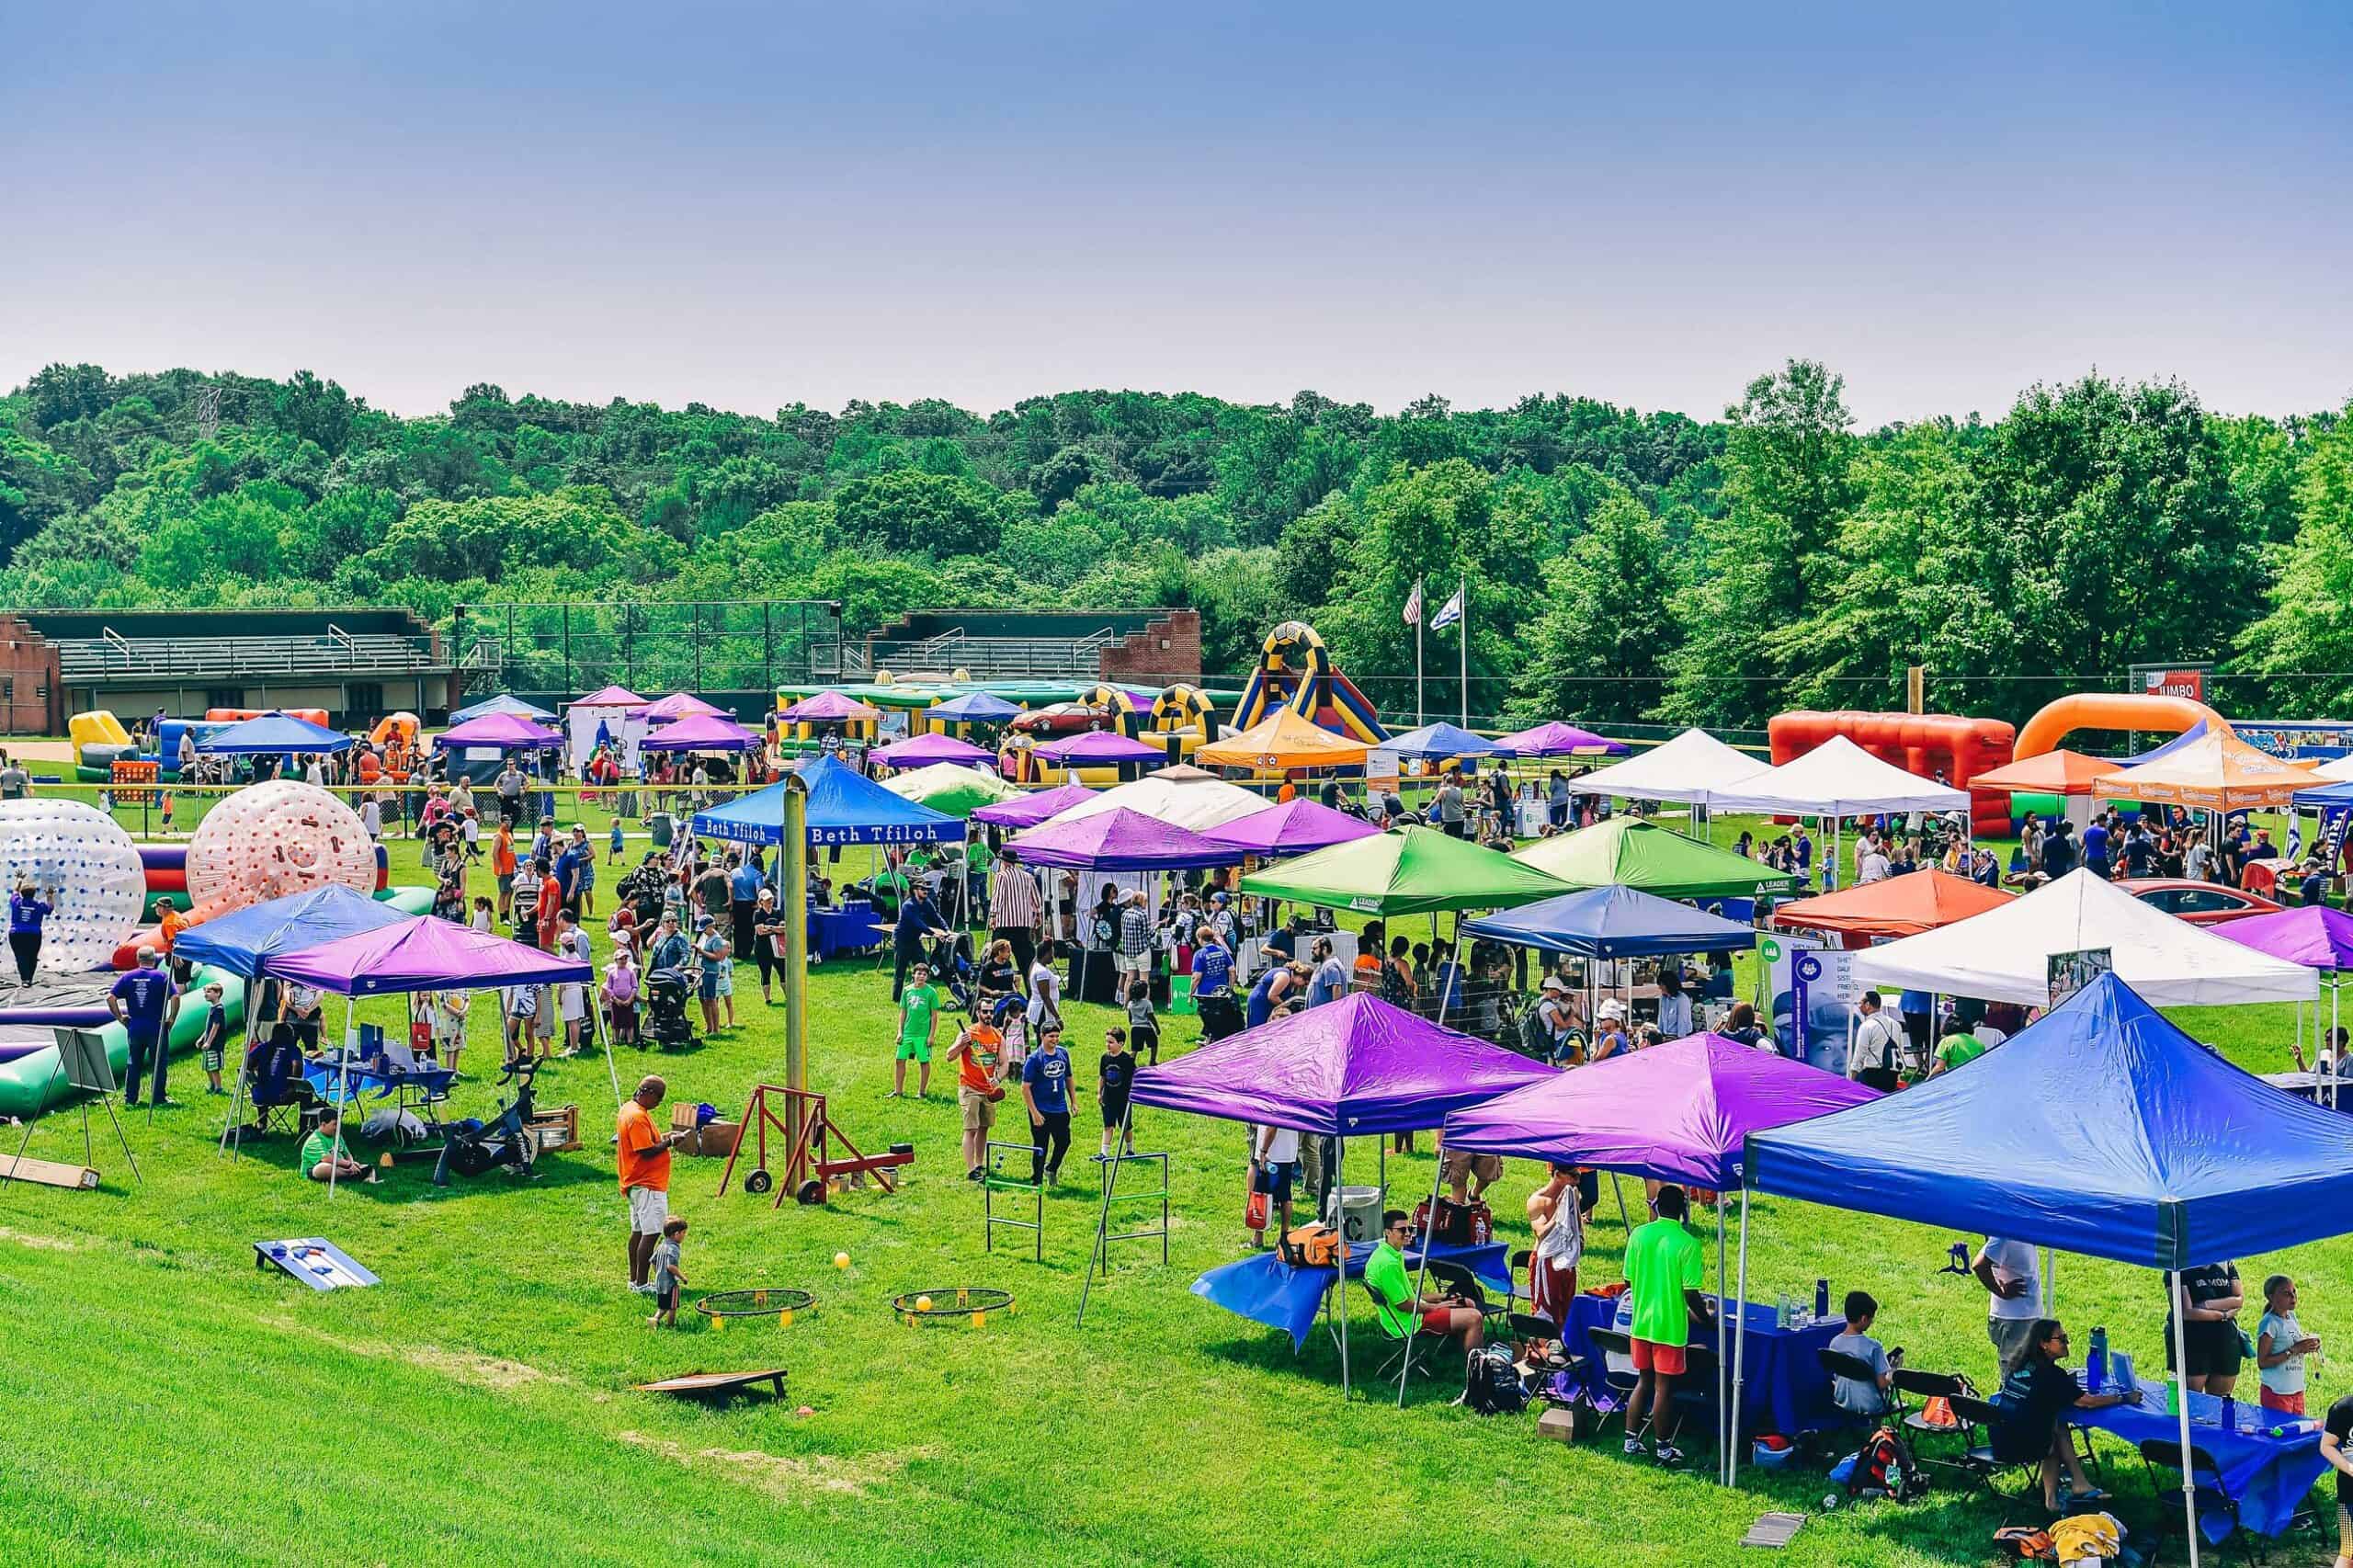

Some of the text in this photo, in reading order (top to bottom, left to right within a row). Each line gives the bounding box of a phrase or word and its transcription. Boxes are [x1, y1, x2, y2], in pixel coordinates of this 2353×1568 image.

[706, 819, 766, 842] Beth Tfiloh
[812, 826, 938, 844] Beth Tfiloh
[2325, 812, 2345, 871] TRUMP
